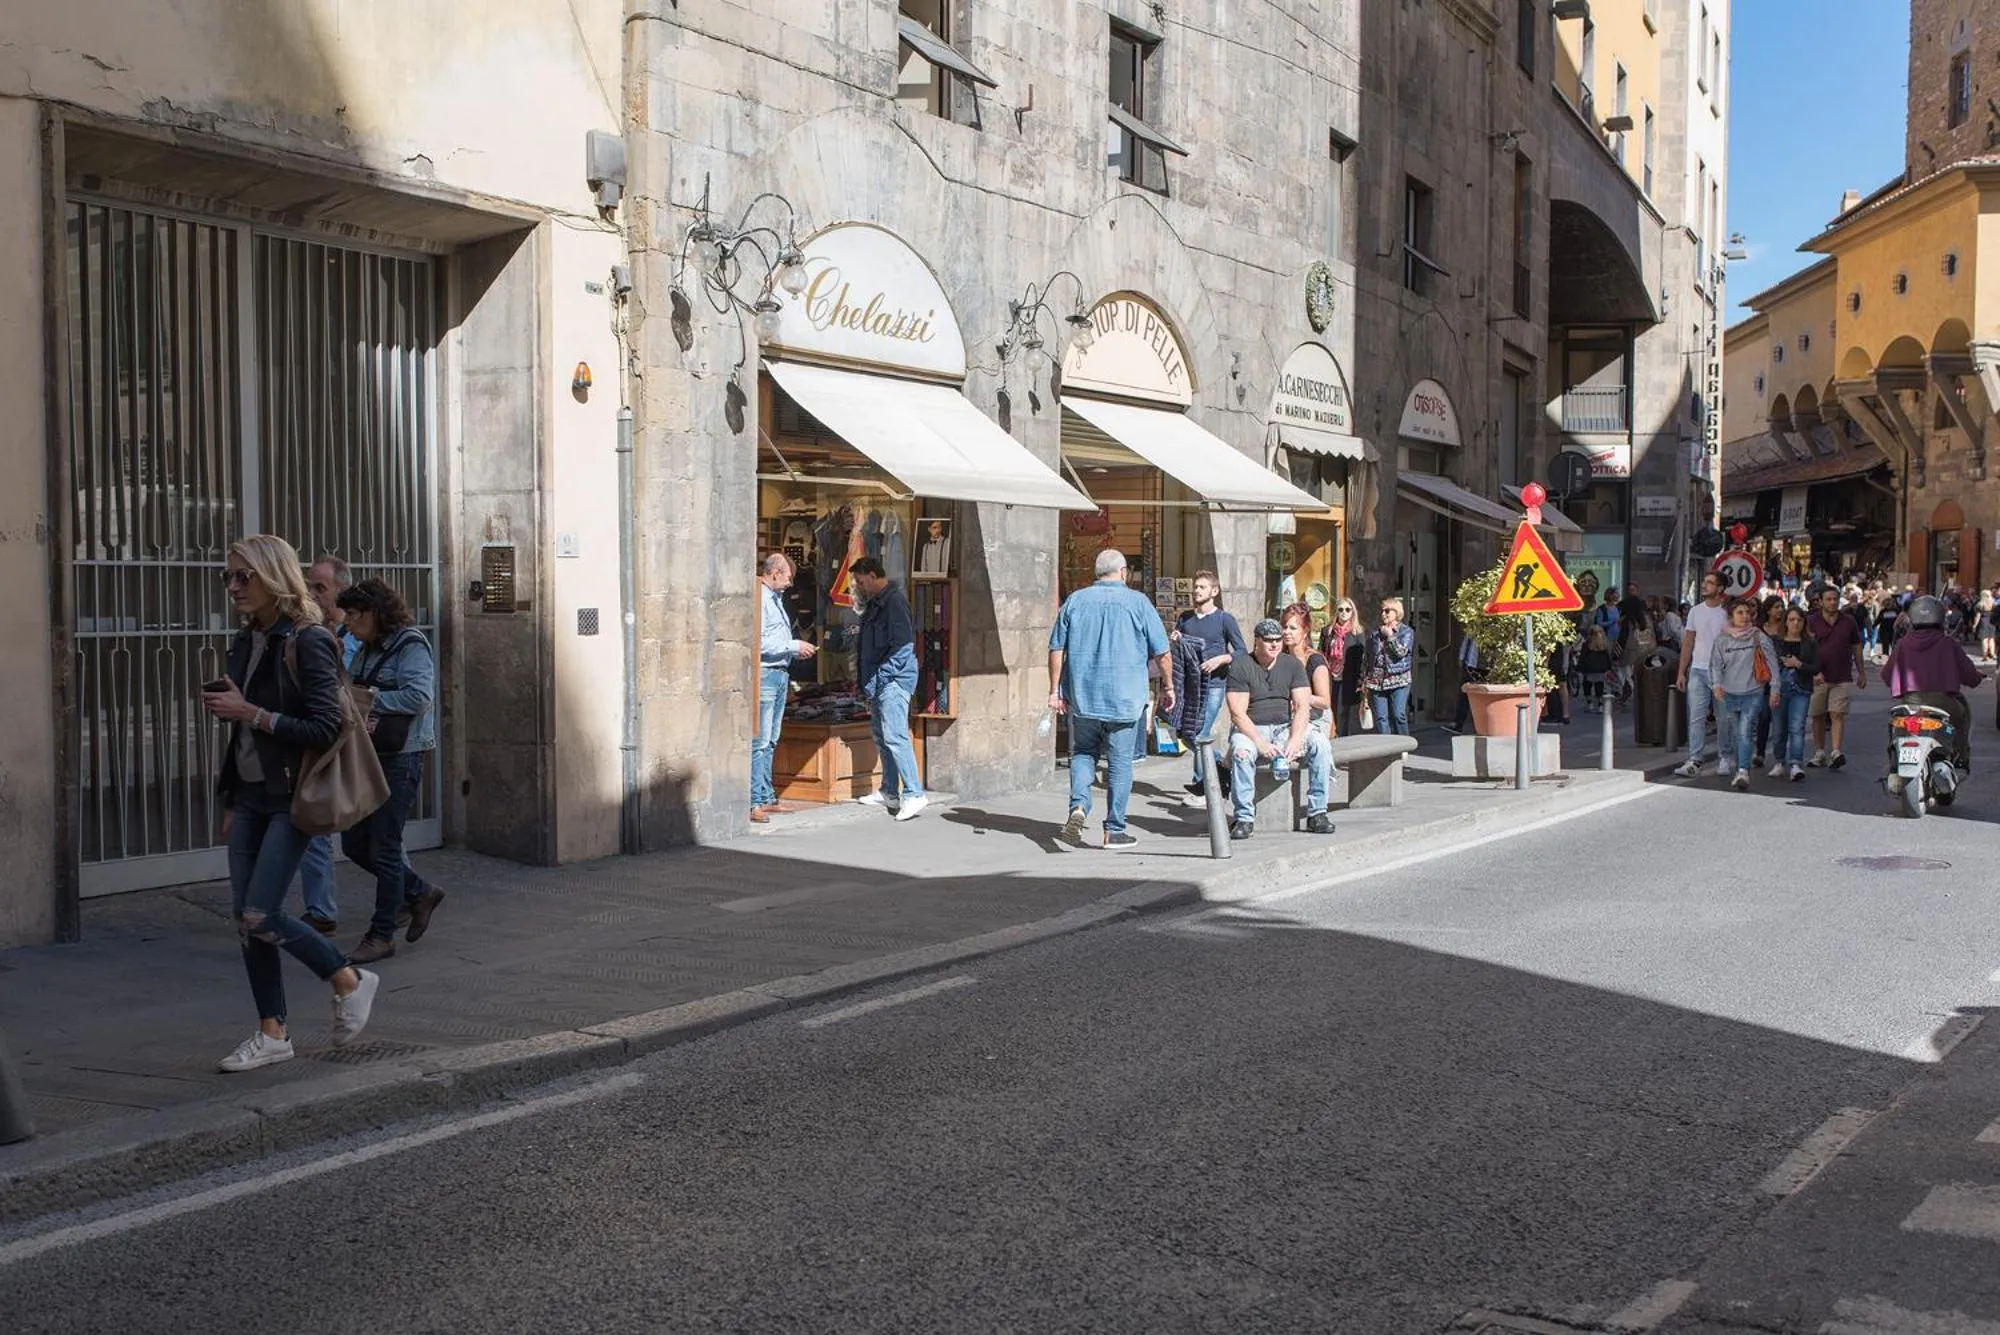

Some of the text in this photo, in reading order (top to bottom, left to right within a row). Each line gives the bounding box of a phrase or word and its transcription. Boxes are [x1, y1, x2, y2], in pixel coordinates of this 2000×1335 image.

[803, 256, 936, 343] Chelazzi
[1125, 301, 1141, 335] DI
[1143, 313, 1184, 385] PELLE
[1285, 404, 1311, 420] MARINO
[1591, 464, 1627, 475] OTTICA
[1722, 564, 1751, 588] 30
